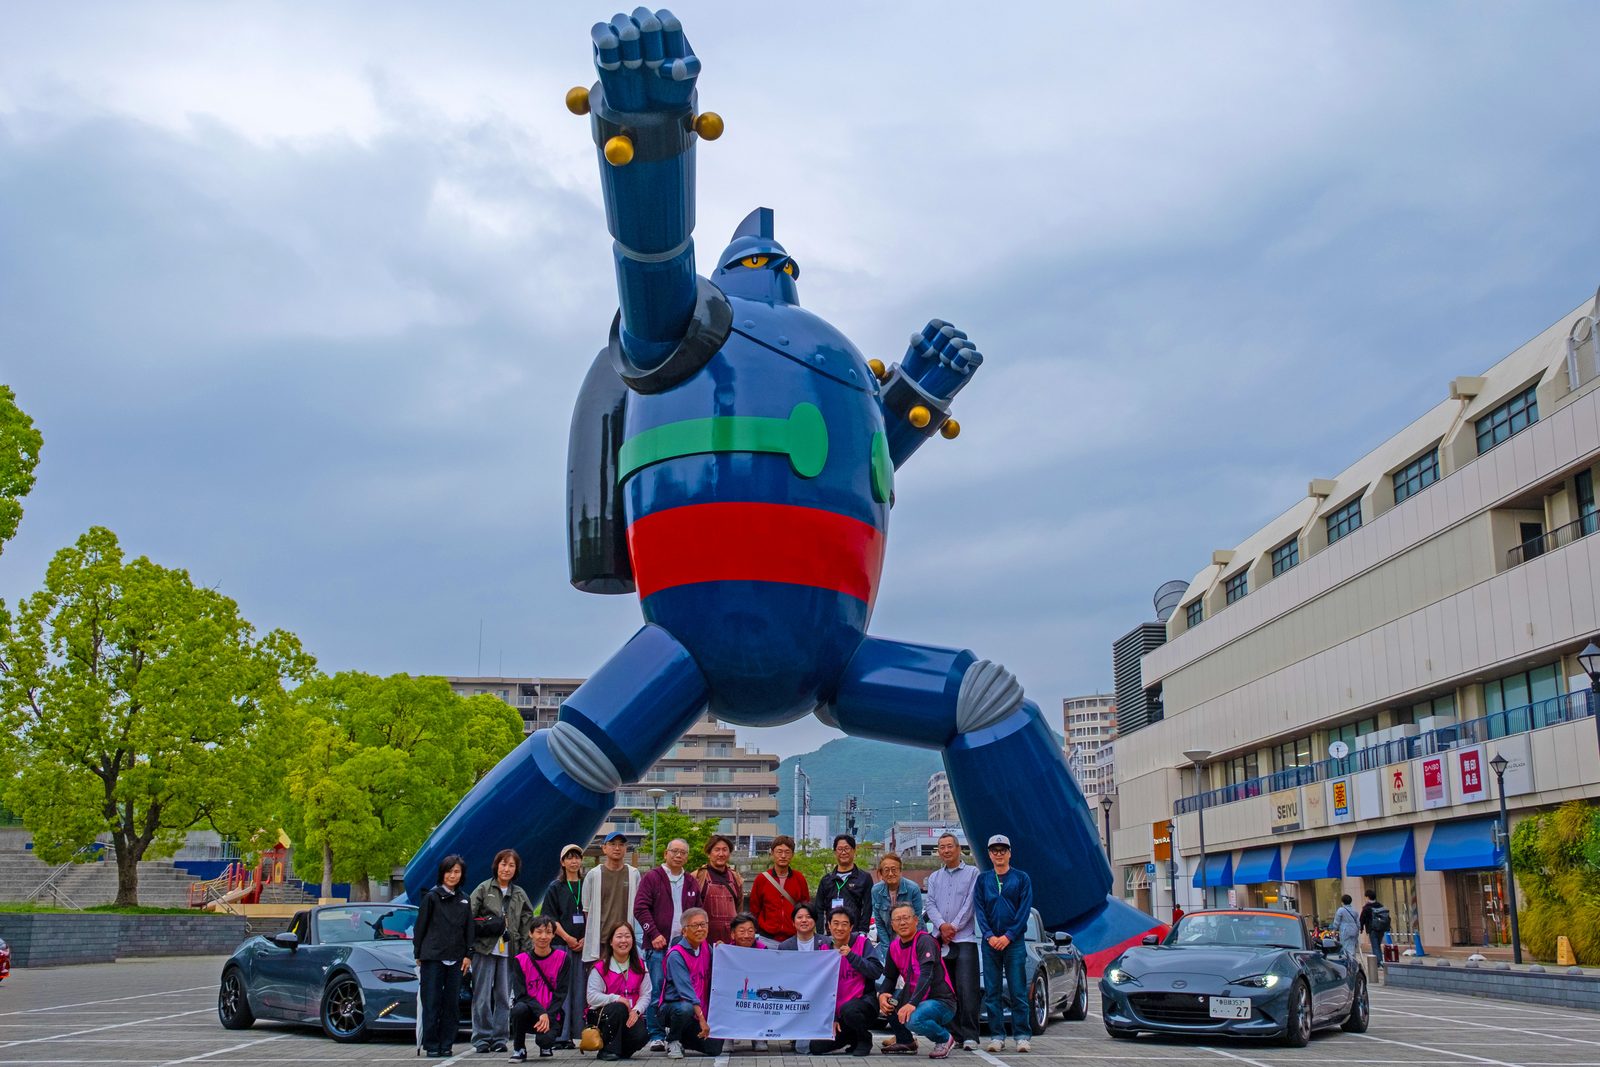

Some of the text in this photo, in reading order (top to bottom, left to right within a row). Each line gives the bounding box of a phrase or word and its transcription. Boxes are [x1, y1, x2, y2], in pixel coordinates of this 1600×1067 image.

[1424, 763, 1439, 772] DAISO
[1335, 783, 1346, 807] 薬
[1277, 802, 1298, 820] SEIYU
[735, 1000, 810, 1011] KOBE ROADSTER MEETING
[1236, 1006, 1249, 1018] 27
